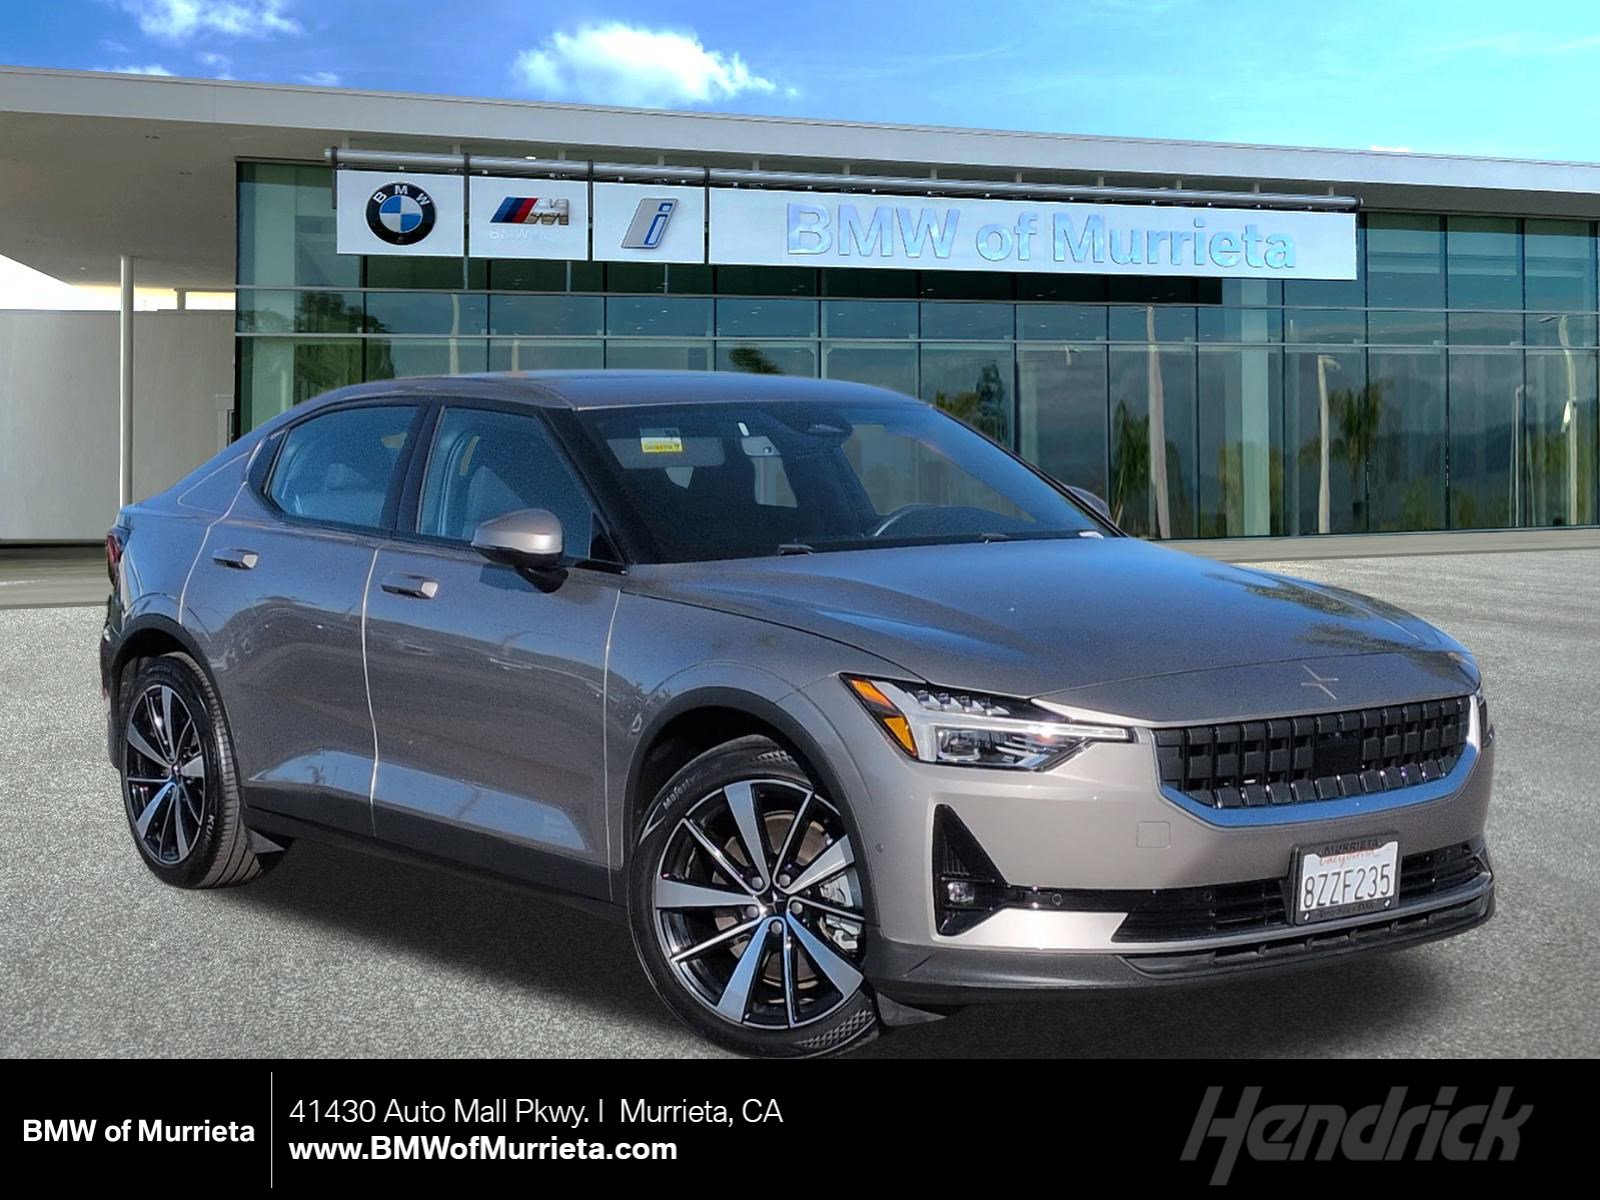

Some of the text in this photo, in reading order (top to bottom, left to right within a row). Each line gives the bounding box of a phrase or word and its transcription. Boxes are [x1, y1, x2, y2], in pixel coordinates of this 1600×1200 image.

[372, 184, 431, 206] BMW
[786, 202, 1296, 269] BMW of Murrieta
[1303, 863, 1391, 909] 8ZZF235
